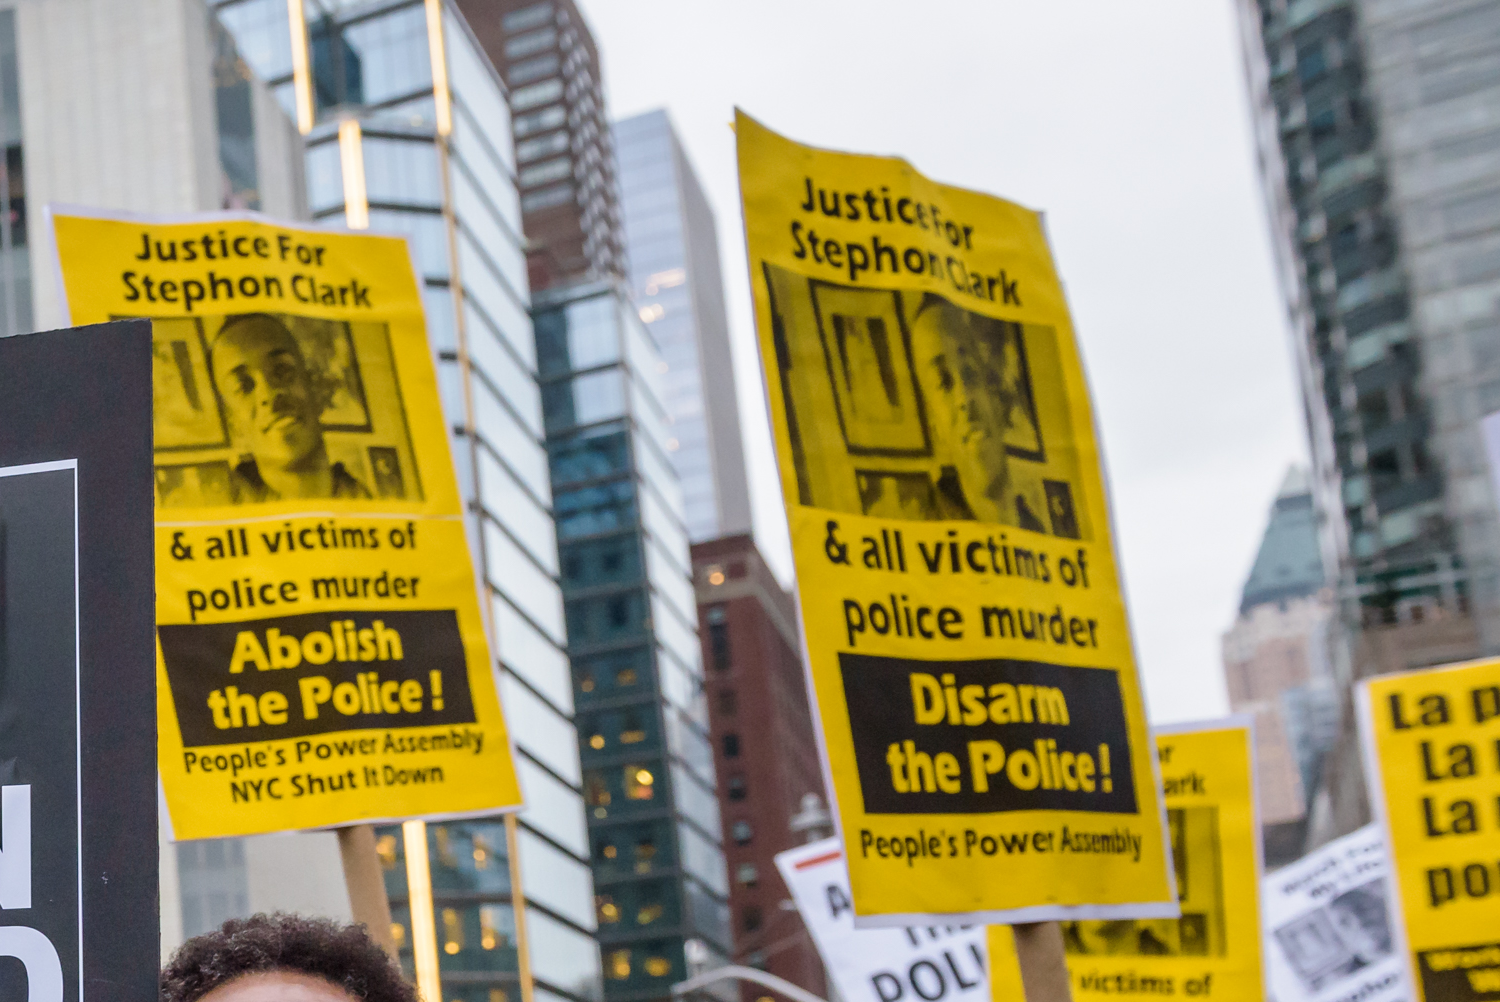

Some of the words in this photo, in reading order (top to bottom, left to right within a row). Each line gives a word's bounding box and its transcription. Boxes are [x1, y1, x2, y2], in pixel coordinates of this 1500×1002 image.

[801, 177, 929, 230] Justice
[930, 204, 974, 250] For
[135, 231, 270, 265] Justice
[278, 233, 326, 267] For
[791, 220, 944, 281] Stephon
[946, 255, 1022, 306] Clark
[122, 271, 284, 312] Stephon
[290, 273, 372, 310] Clark
[170, 530, 195, 561] &
[205, 527, 249, 561] all
[260, 523, 380, 554] victims
[388, 521, 418, 551] of
[824, 519, 852, 566] &
[862, 528, 908, 573] all
[918, 530, 1052, 583] victims
[1059, 547, 1090, 588] of
[187, 578, 299, 622] police
[312, 572, 420, 602] murder
[843, 593, 965, 647] police
[980, 605, 1099, 649] murder
[229, 619, 403, 674] Abolish
[207, 685, 289, 730] the
[909, 672, 1070, 726] Disarm
[1389, 693, 1451, 731] La
[184, 745, 286, 777] People's
[296, 733, 377, 762] Power
[383, 728, 484, 755] Assembly
[886, 739, 961, 794] the
[1420, 740, 1476, 781] La
[230, 777, 283, 803] NYC
[290, 769, 357, 798] Shut
[363, 766, 381, 788] It
[383, 764, 444, 786] Down
[1164, 769, 1206, 796] ark
[1422, 797, 1478, 837] La
[860, 829, 958, 868] People's
[964, 829, 1055, 857] Power
[1060, 823, 1142, 862] Assembly
[1426, 863, 1500, 907] po
[1080, 969, 1175, 995] victims
[1184, 973, 1213, 998] of
